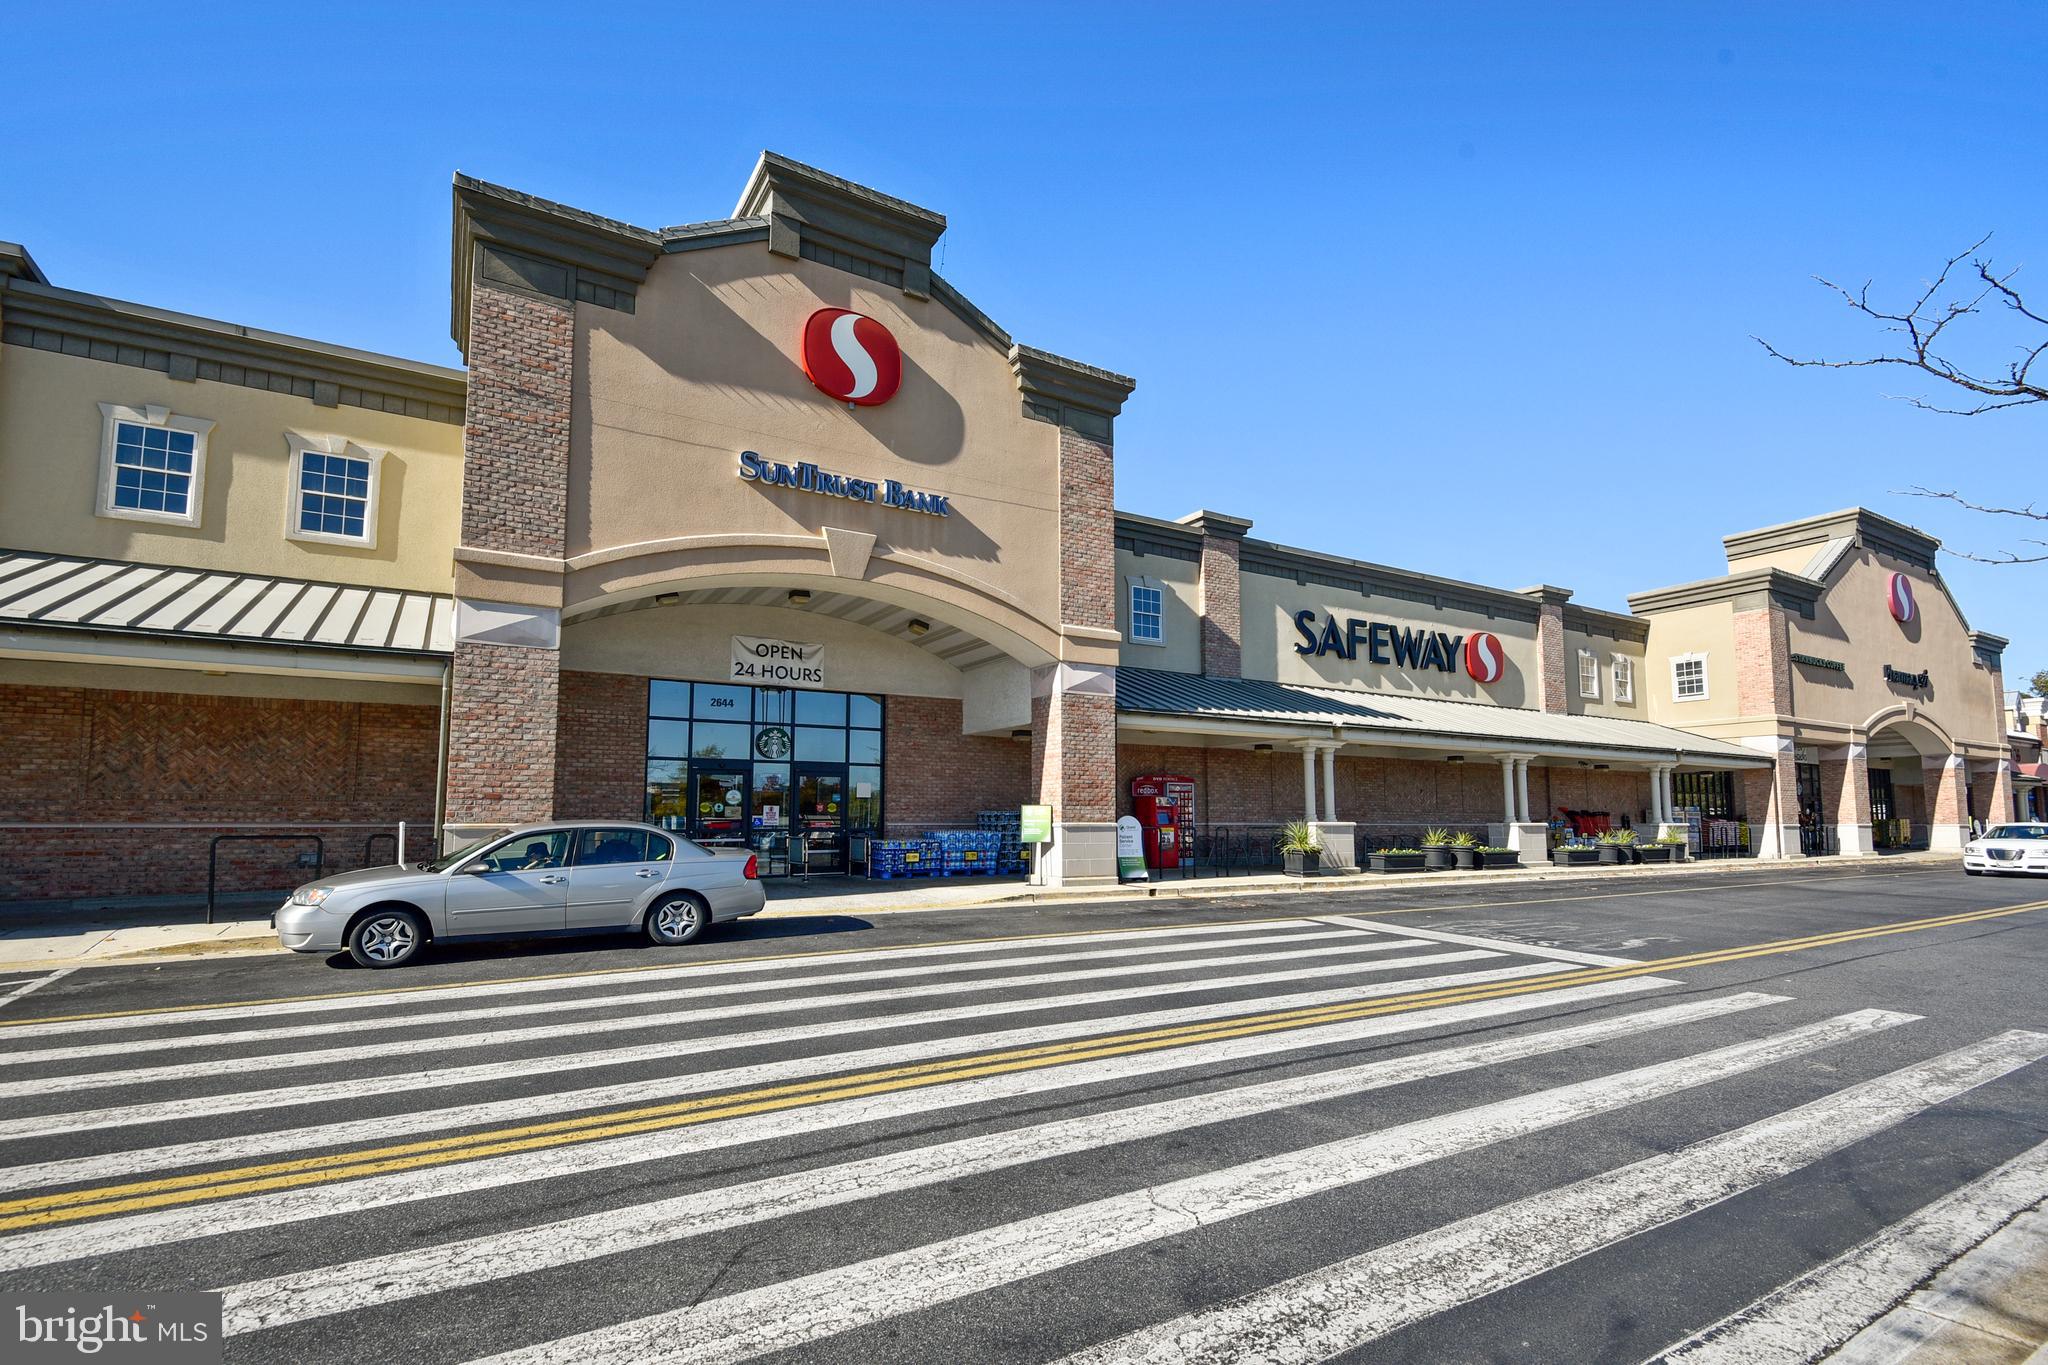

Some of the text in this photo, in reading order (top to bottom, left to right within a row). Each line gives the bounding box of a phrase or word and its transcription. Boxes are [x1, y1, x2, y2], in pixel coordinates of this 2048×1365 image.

[1294, 609, 1464, 673] SAFEWAY
[755, 643, 803, 661] OPEN
[734, 661, 822, 683] 24 HOURS
[710, 697, 735, 708] 2644
[1137, 786, 1158, 794] redbox
